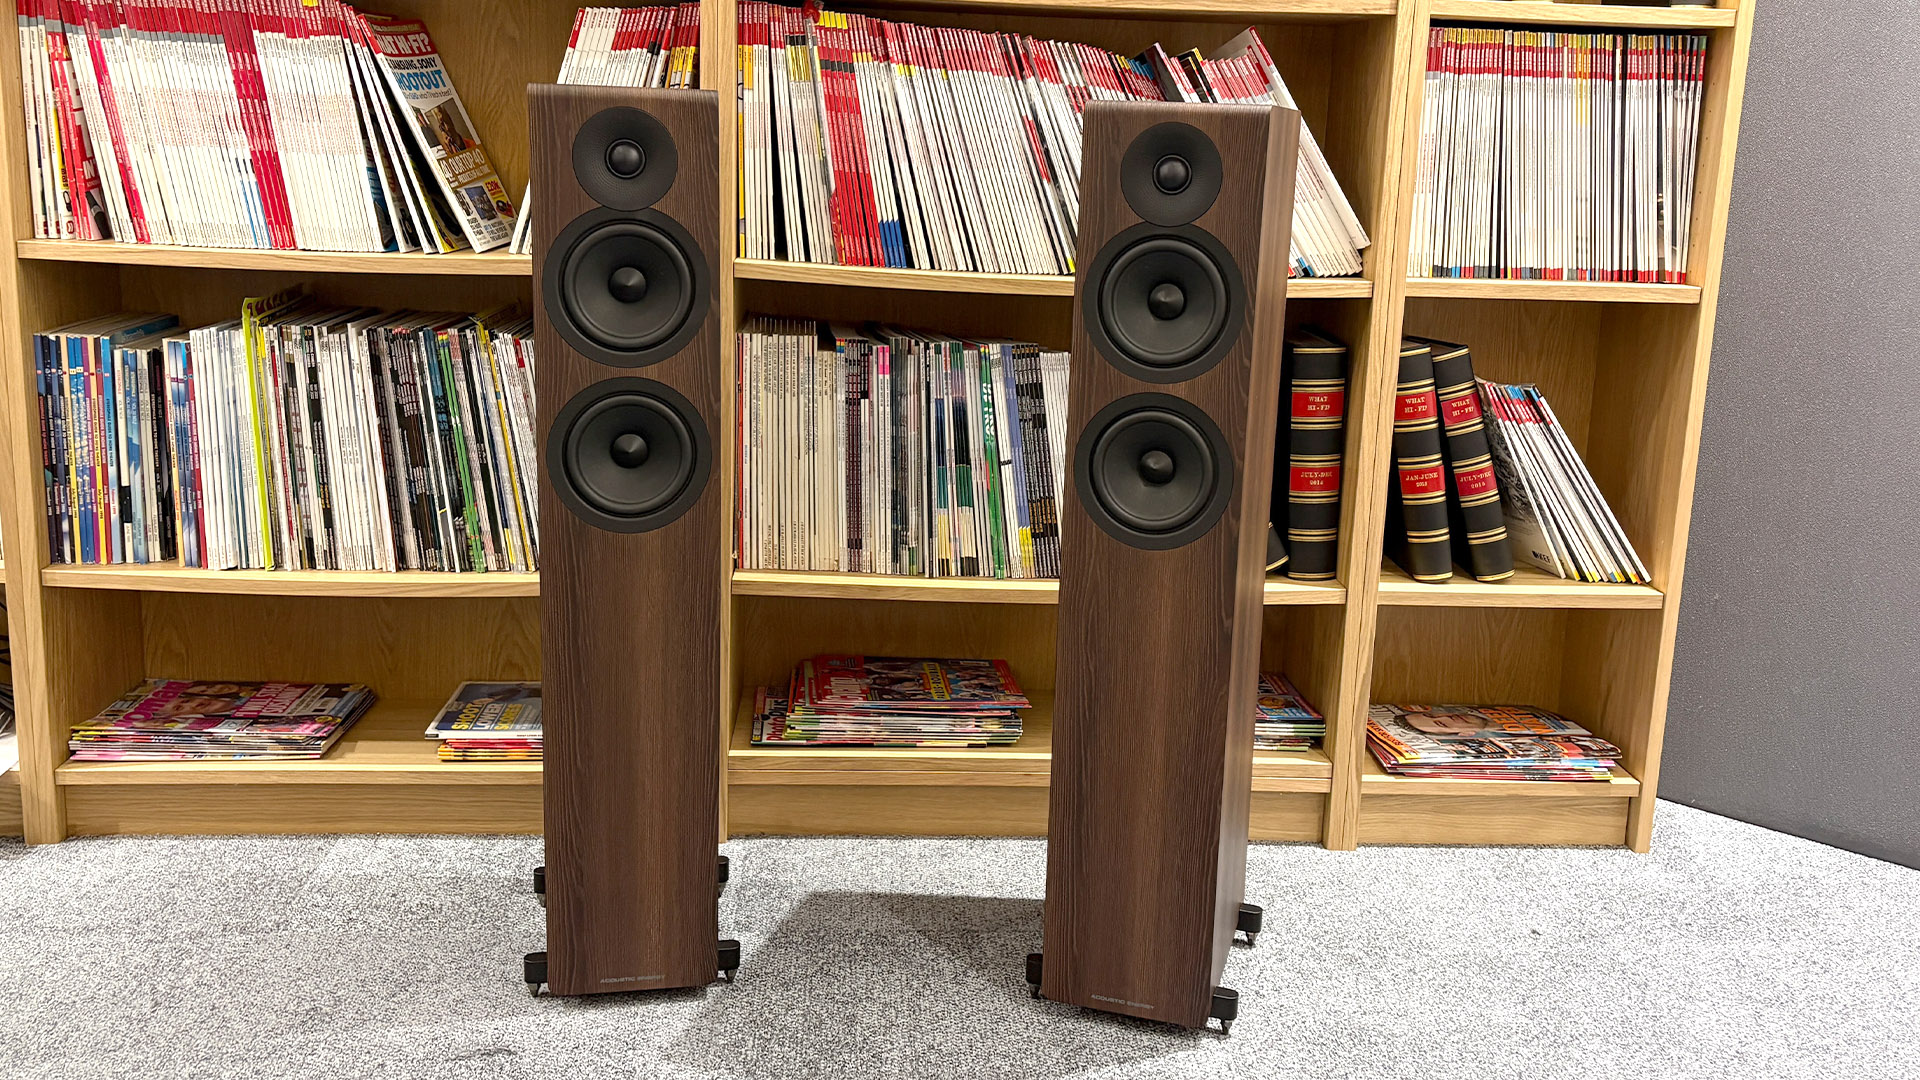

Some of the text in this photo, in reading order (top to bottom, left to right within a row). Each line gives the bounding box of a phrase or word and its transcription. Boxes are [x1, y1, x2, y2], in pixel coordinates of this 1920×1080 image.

[394, 33, 432, 54] HI-FI?
[418, 57, 437, 70] SONY
[1405, 396, 1425, 404] WHAT
[1451, 398, 1470, 408] WHAT
[1405, 471, 1439, 481] JAN-JUNE
[451, 704, 483, 730] SHOOT
[472, 703, 504, 730] LOWER
[494, 703, 523, 730] SCORES
[1479, 708, 1524, 731] DEEP
